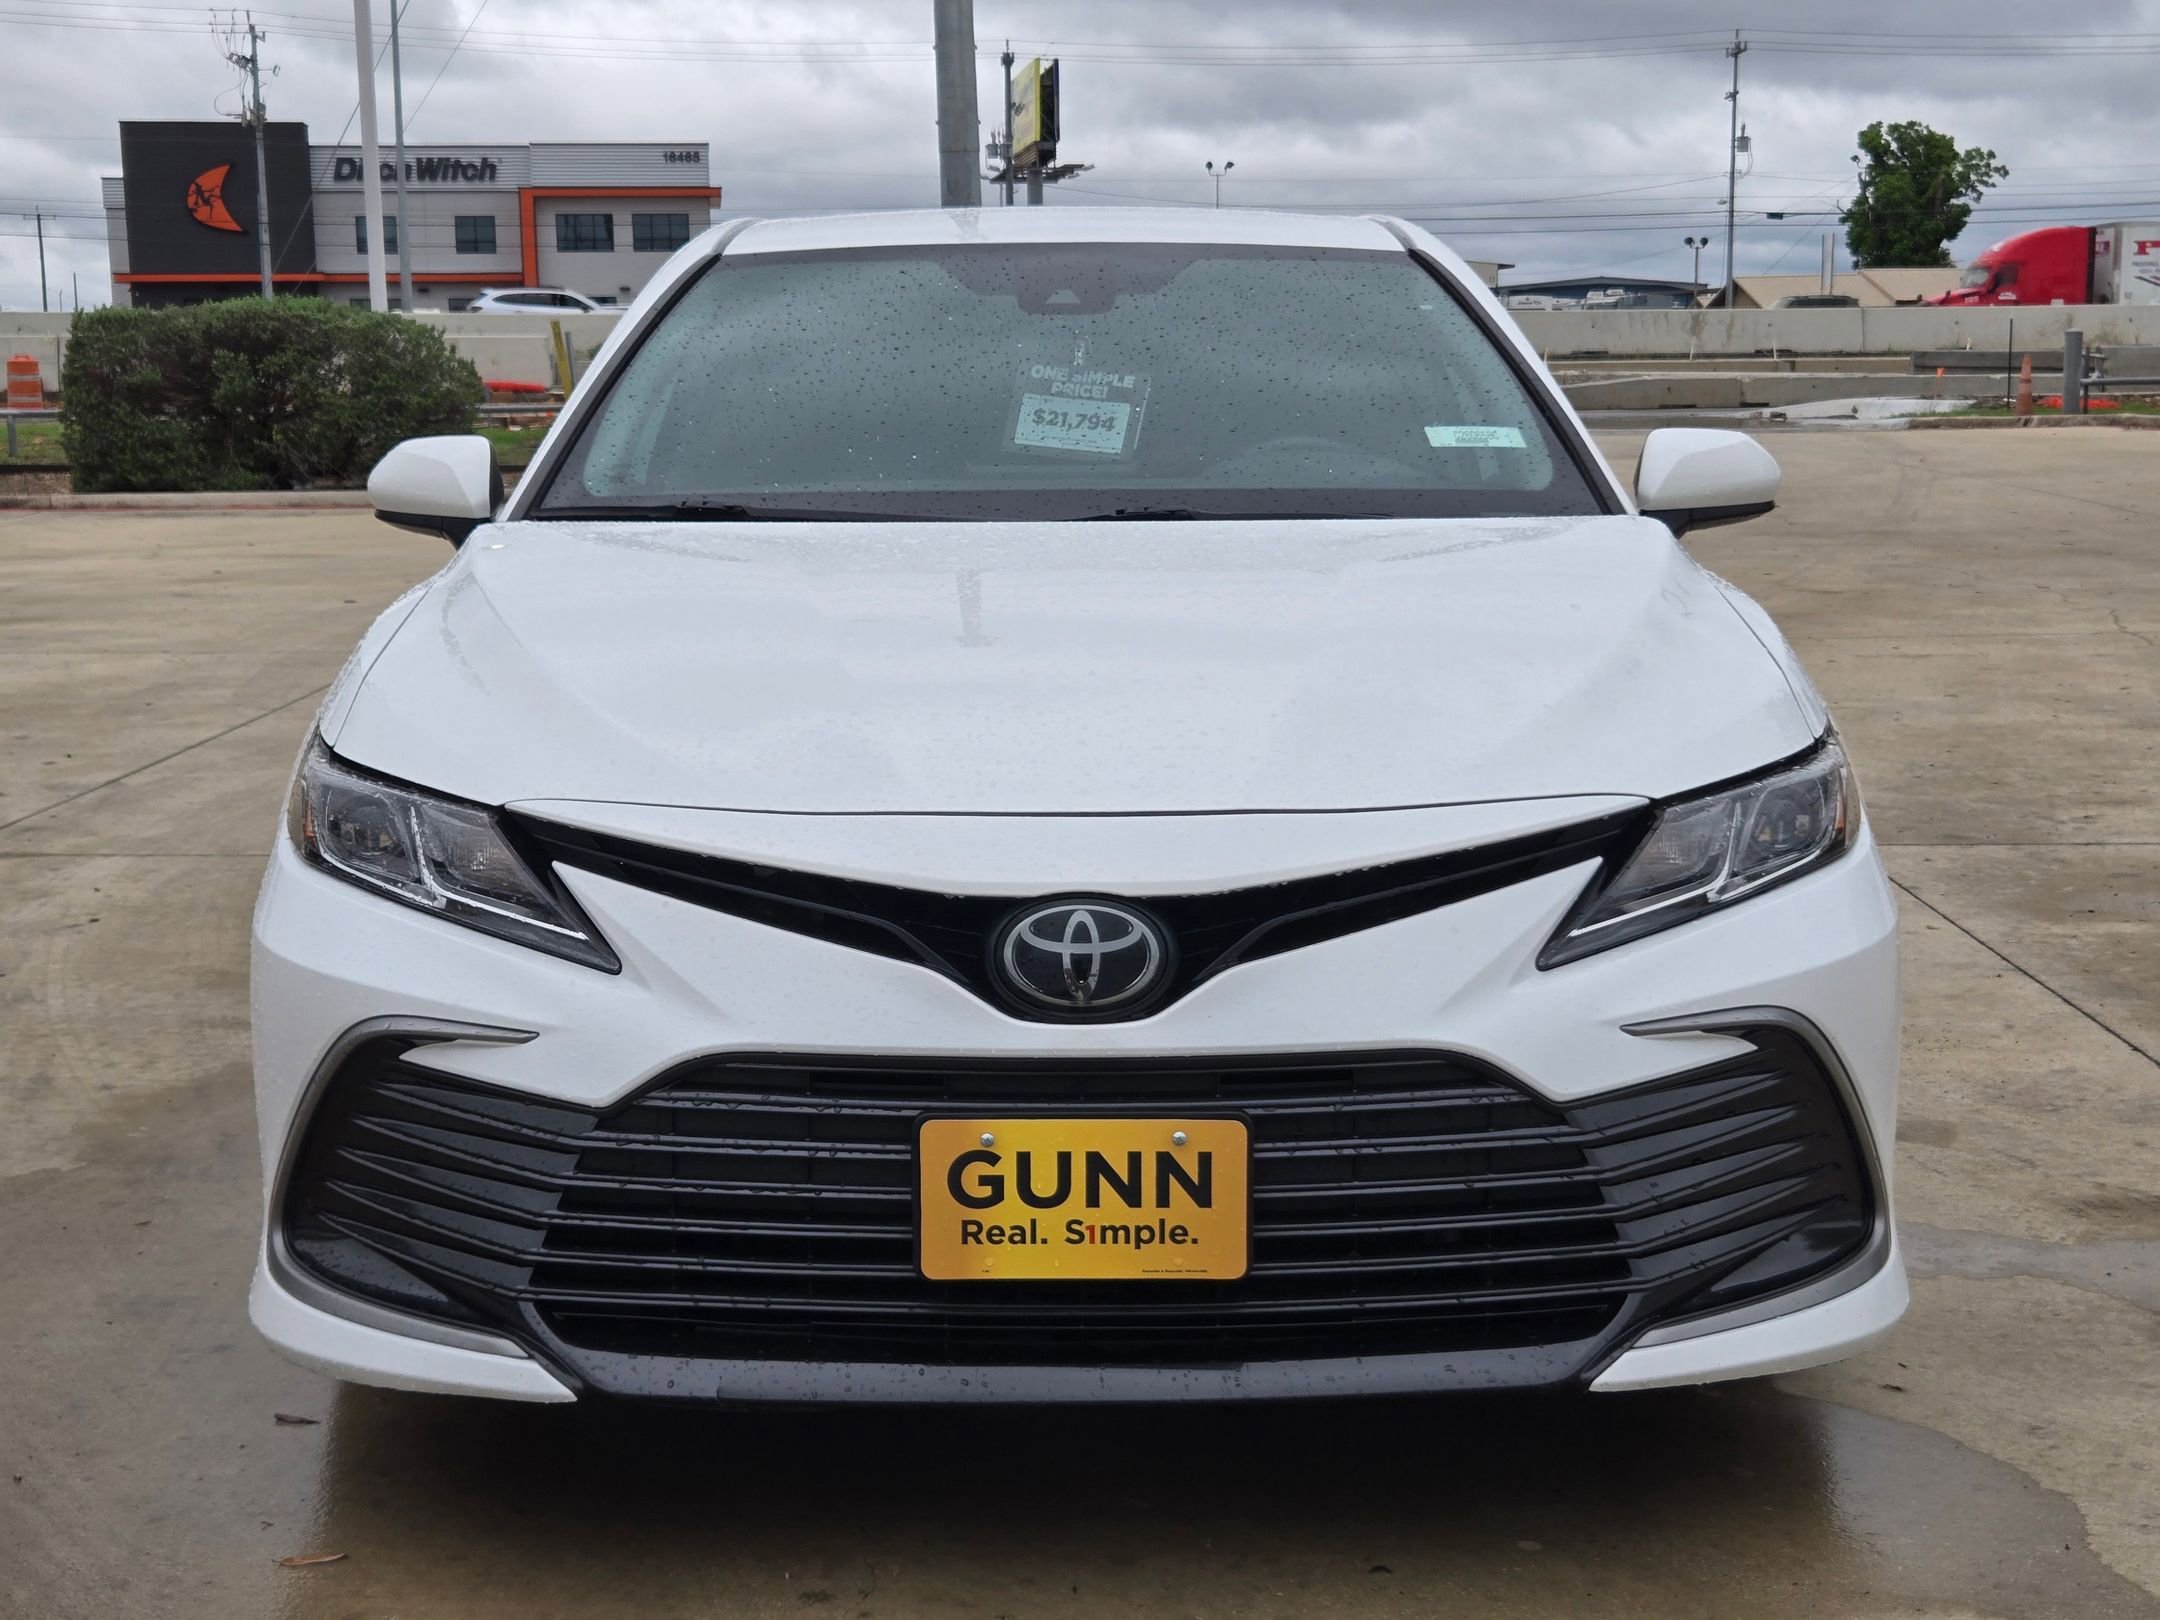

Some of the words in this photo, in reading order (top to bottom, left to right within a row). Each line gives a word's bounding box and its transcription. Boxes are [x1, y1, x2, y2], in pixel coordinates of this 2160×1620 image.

[415, 157, 498, 182] Witch
[1030, 364, 1069, 382] ONE
[1050, 381, 1109, 399] PRICE!
[1031, 407, 1116, 433] $21,794
[946, 1148, 1213, 1210] GUNN
[960, 1218, 1048, 1245] Real.
